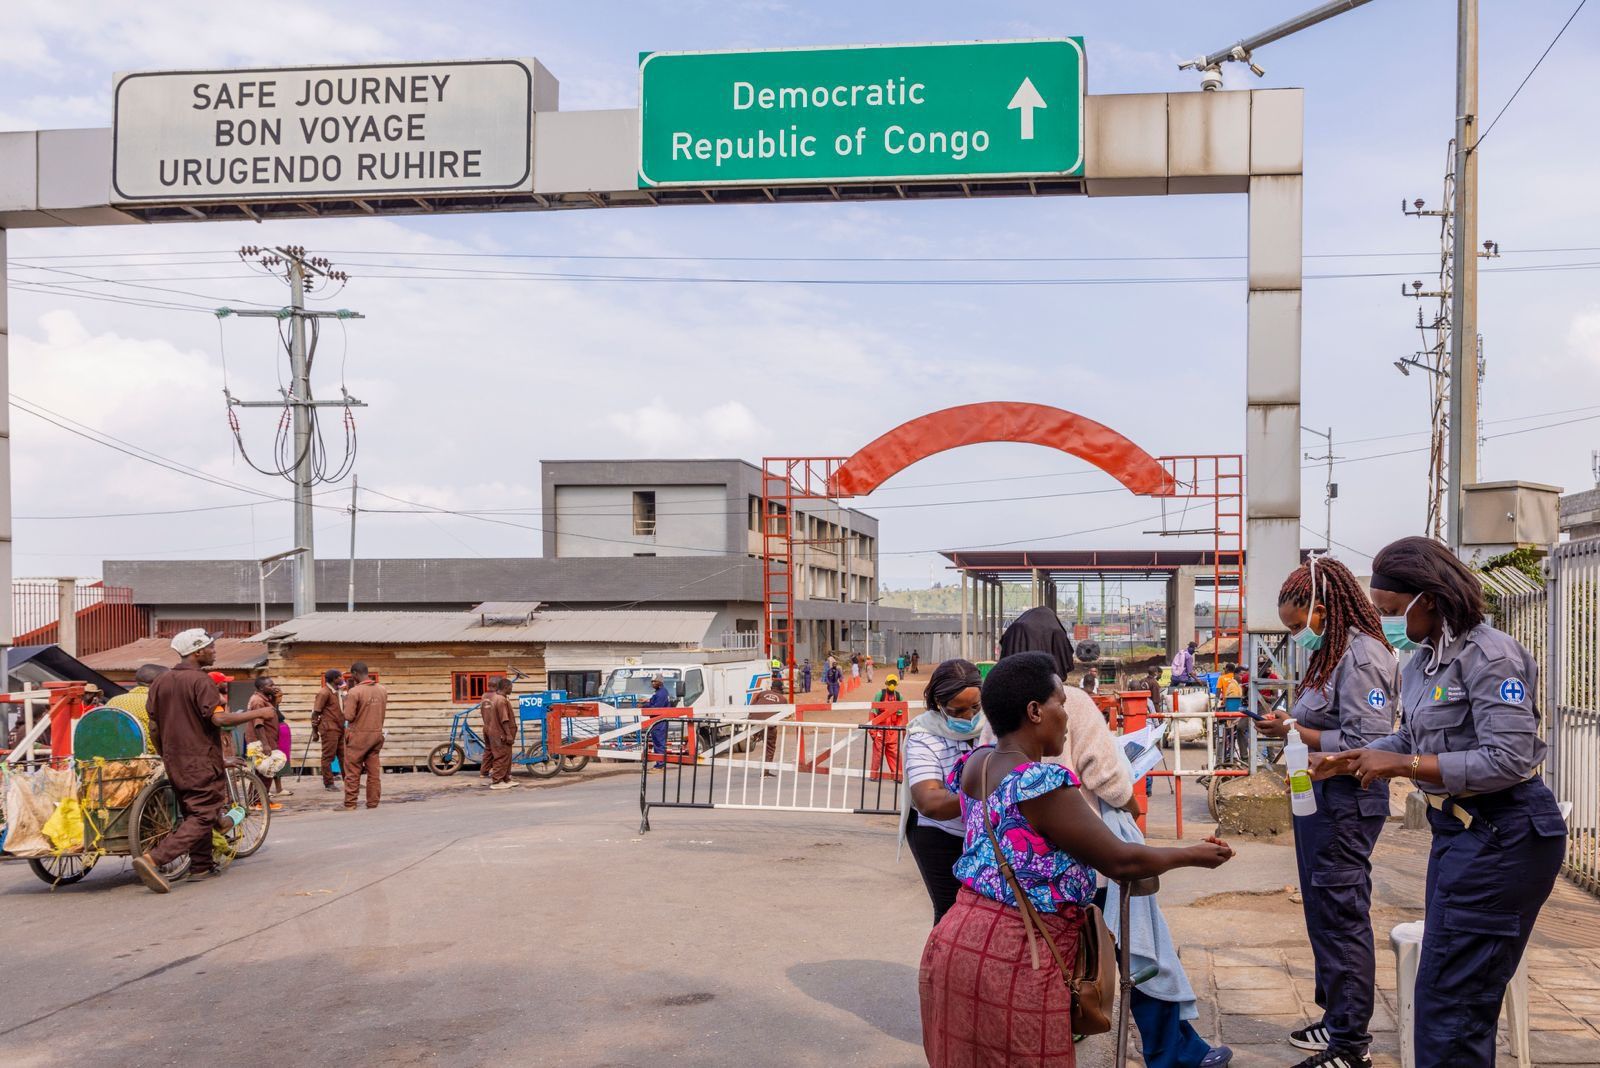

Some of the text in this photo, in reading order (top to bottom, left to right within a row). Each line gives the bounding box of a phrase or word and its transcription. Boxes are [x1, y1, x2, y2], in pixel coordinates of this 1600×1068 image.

[193, 75, 451, 110] SAFE JOURNEY
[733, 75, 926, 110] Democratic
[215, 114, 426, 147] BON VOYAGE
[672, 125, 990, 167] Republic of Congo
[159, 150, 482, 187] URUGENDO RUHIRE
